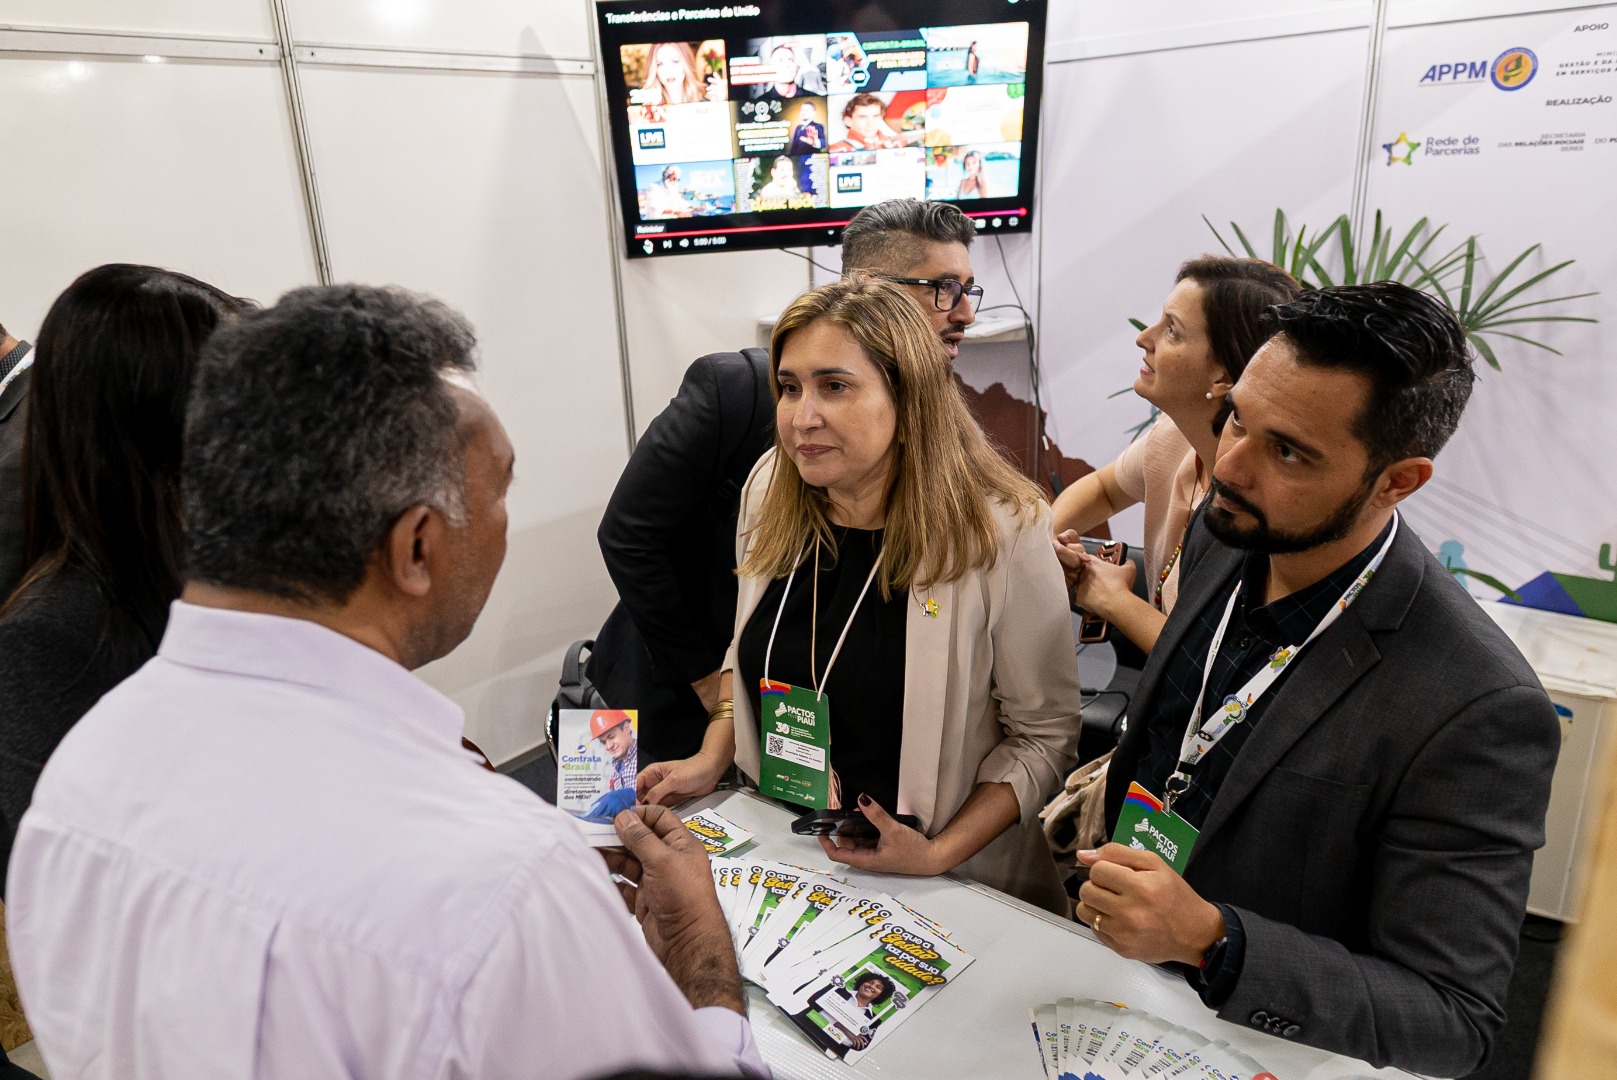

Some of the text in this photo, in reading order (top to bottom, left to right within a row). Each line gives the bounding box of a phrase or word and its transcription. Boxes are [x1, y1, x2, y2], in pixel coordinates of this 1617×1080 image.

[1574, 23, 1609, 32] APOIO
[1559, 60, 1591, 68] GESTÃO
[1420, 60, 1488, 82] APPM
[1570, 68, 1611, 76] SERVIÇOS
[1546, 95, 1612, 106] REALIZAÇÃO
[1426, 134, 1480, 146] Rede de
[1425, 145, 1480, 156] Parcerias
[788, 705, 816, 718] PACTOS
[1148, 825, 1178, 854] PACTOS
[902, 932, 923, 945] que
[885, 944, 940, 975] faz por sua
